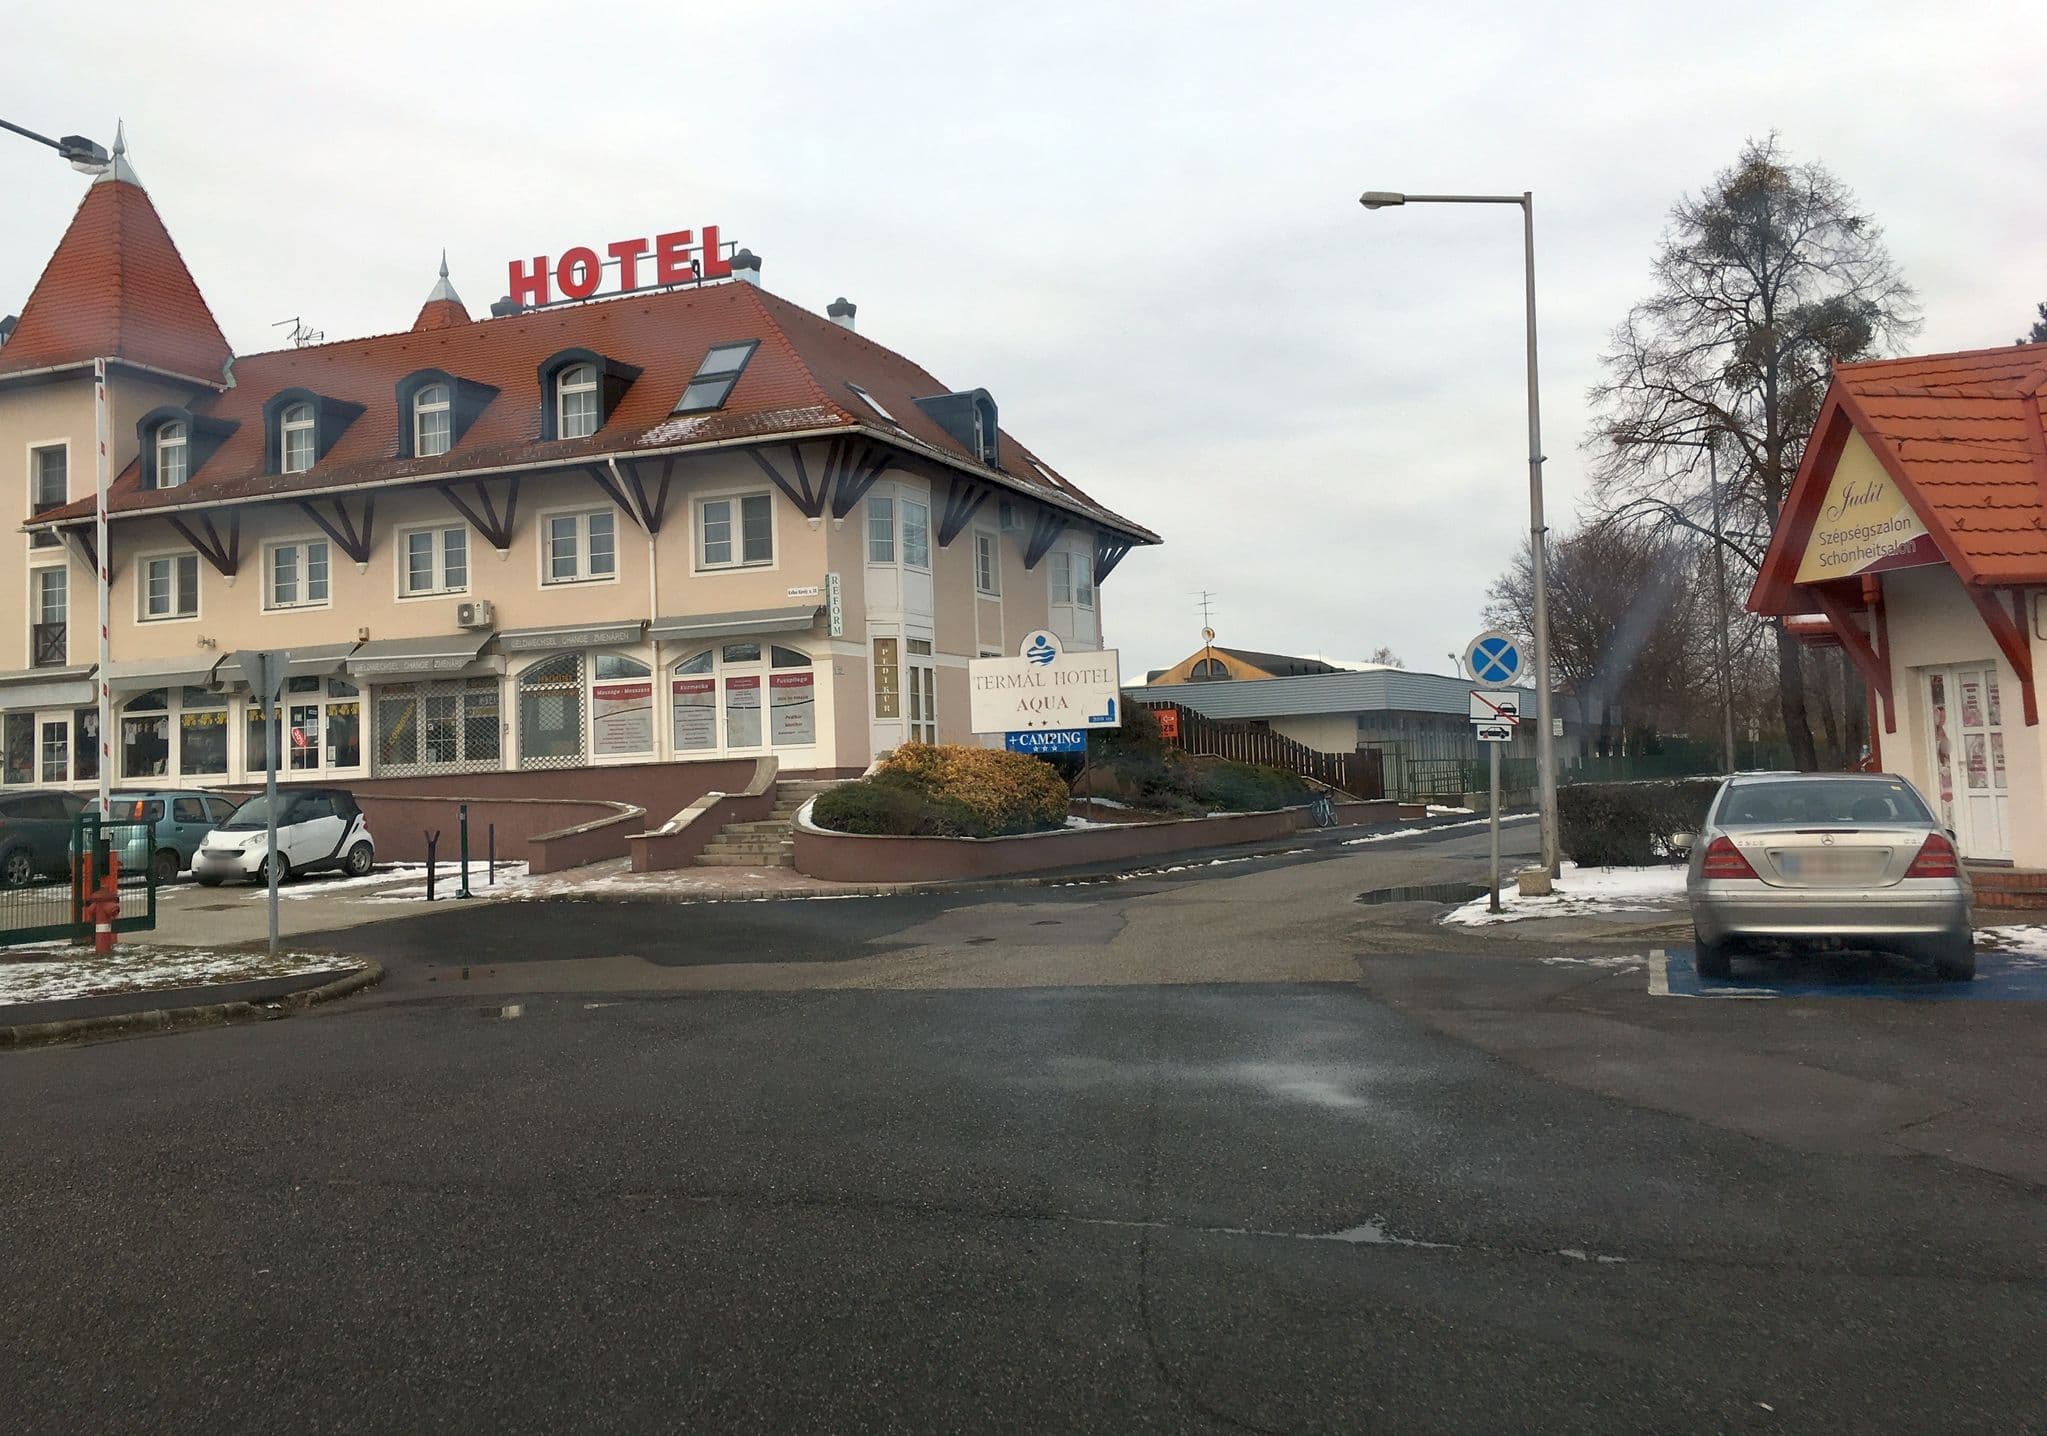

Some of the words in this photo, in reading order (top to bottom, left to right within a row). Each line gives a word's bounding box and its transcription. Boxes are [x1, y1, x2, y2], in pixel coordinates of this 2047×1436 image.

[509, 225, 733, 305] HOTEL
[1827, 481, 1884, 522] Judit
[1819, 517, 1911, 546] Szépségszalon
[831, 576, 841, 635] REFORM
[562, 635, 589, 646] CHANGE
[974, 669, 1046, 690] TERMÁL
[1054, 668, 1114, 686] HOTEL
[1016, 696, 1069, 713] AQUA
